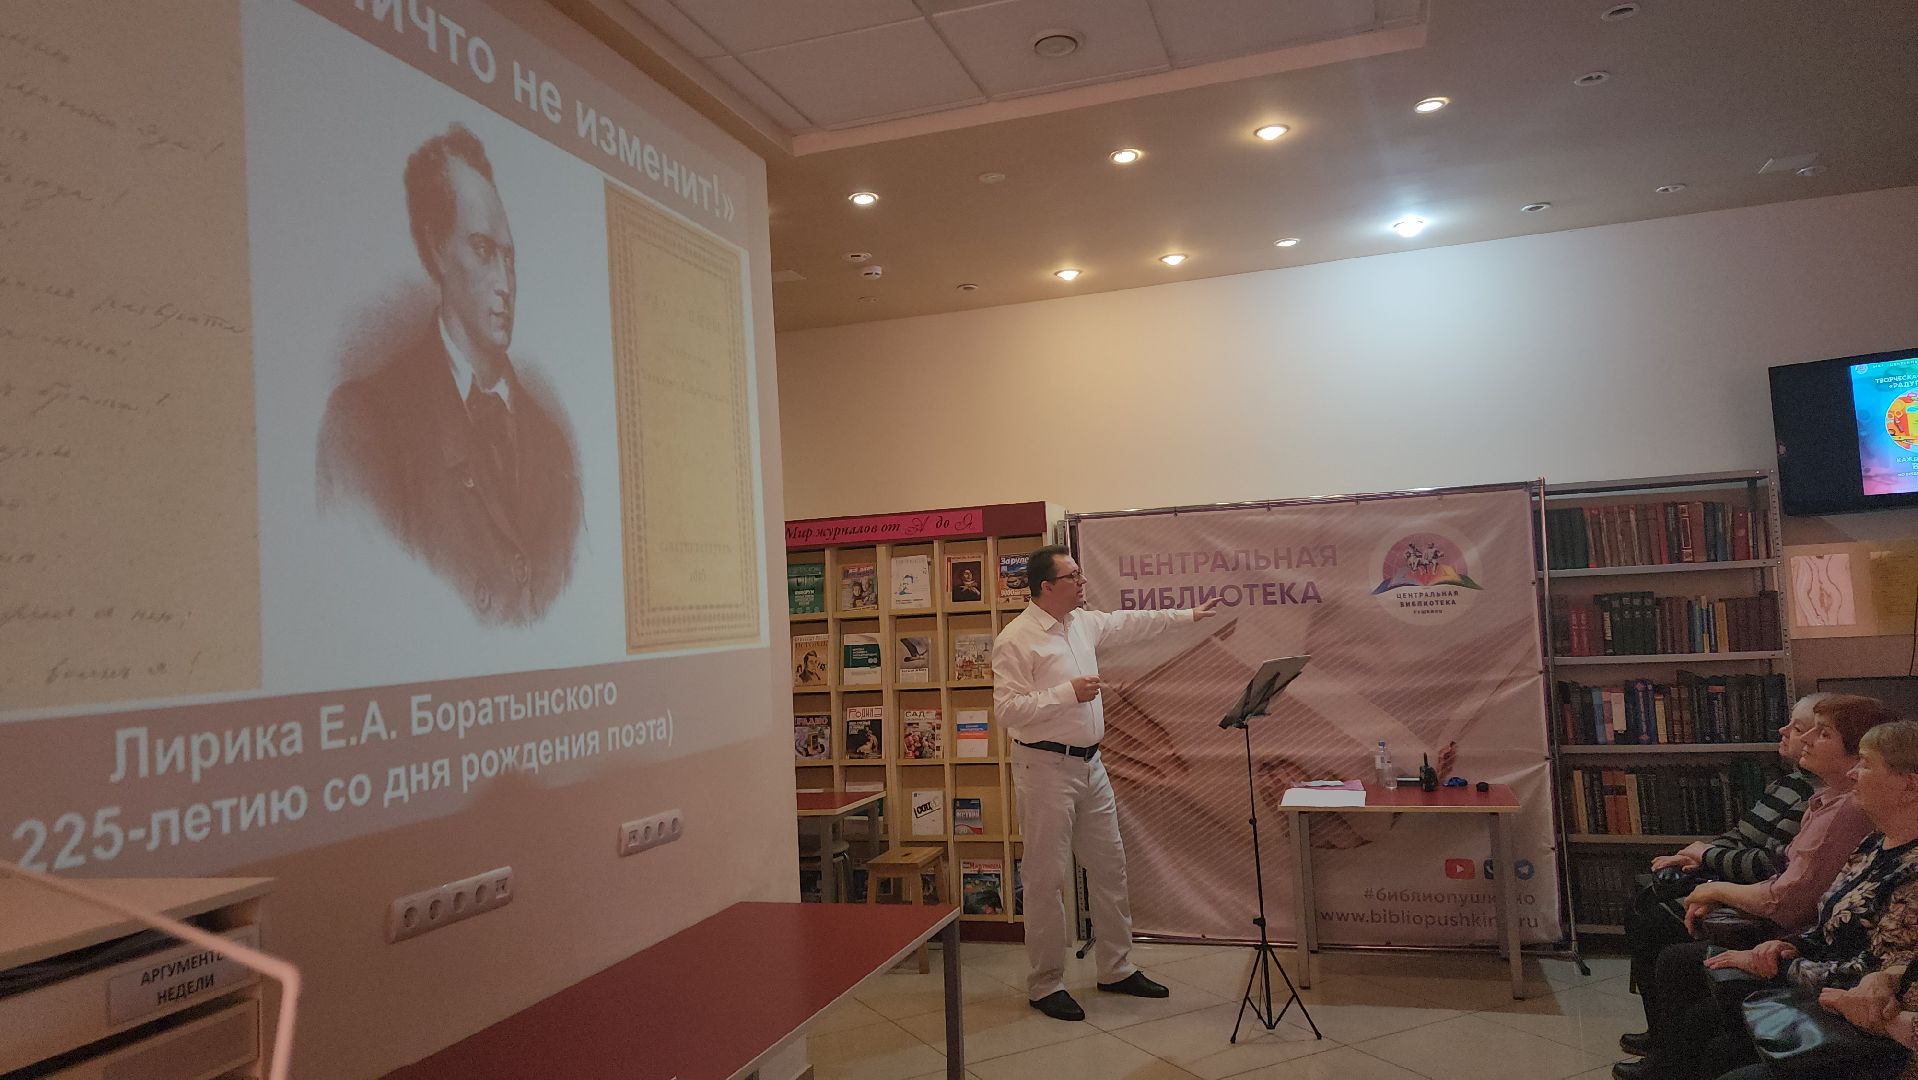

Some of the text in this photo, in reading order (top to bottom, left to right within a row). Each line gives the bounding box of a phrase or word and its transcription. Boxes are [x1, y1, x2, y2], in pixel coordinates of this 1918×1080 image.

[354, 0, 736, 222] ичто не изменит!»
[1874, 374, 1918, 384] ТВОРЧЕСКА
[785, 526, 813, 542] Мир
[815, 525, 878, 541] журналов
[881, 523, 901, 533] от
[935, 517, 950, 529] до
[1010, 556, 1030, 566] руле
[1118, 545, 1338, 580] ЦЕНТРАЛЬНАЯ
[1120, 581, 1323, 611] БИБЛИОТЕКА
[1396, 590, 1459, 599] ЦЕНТРАЛЬНАЯ
[1400, 599, 1457, 608] БИБЛИОТЕКА
[109, 680, 618, 784] Лирика Е.А. Боратынского
[11, 708, 674, 873] 225-летию со дня рождения поэта)
[156, 973, 215, 1006] НЕДЕЛИ
